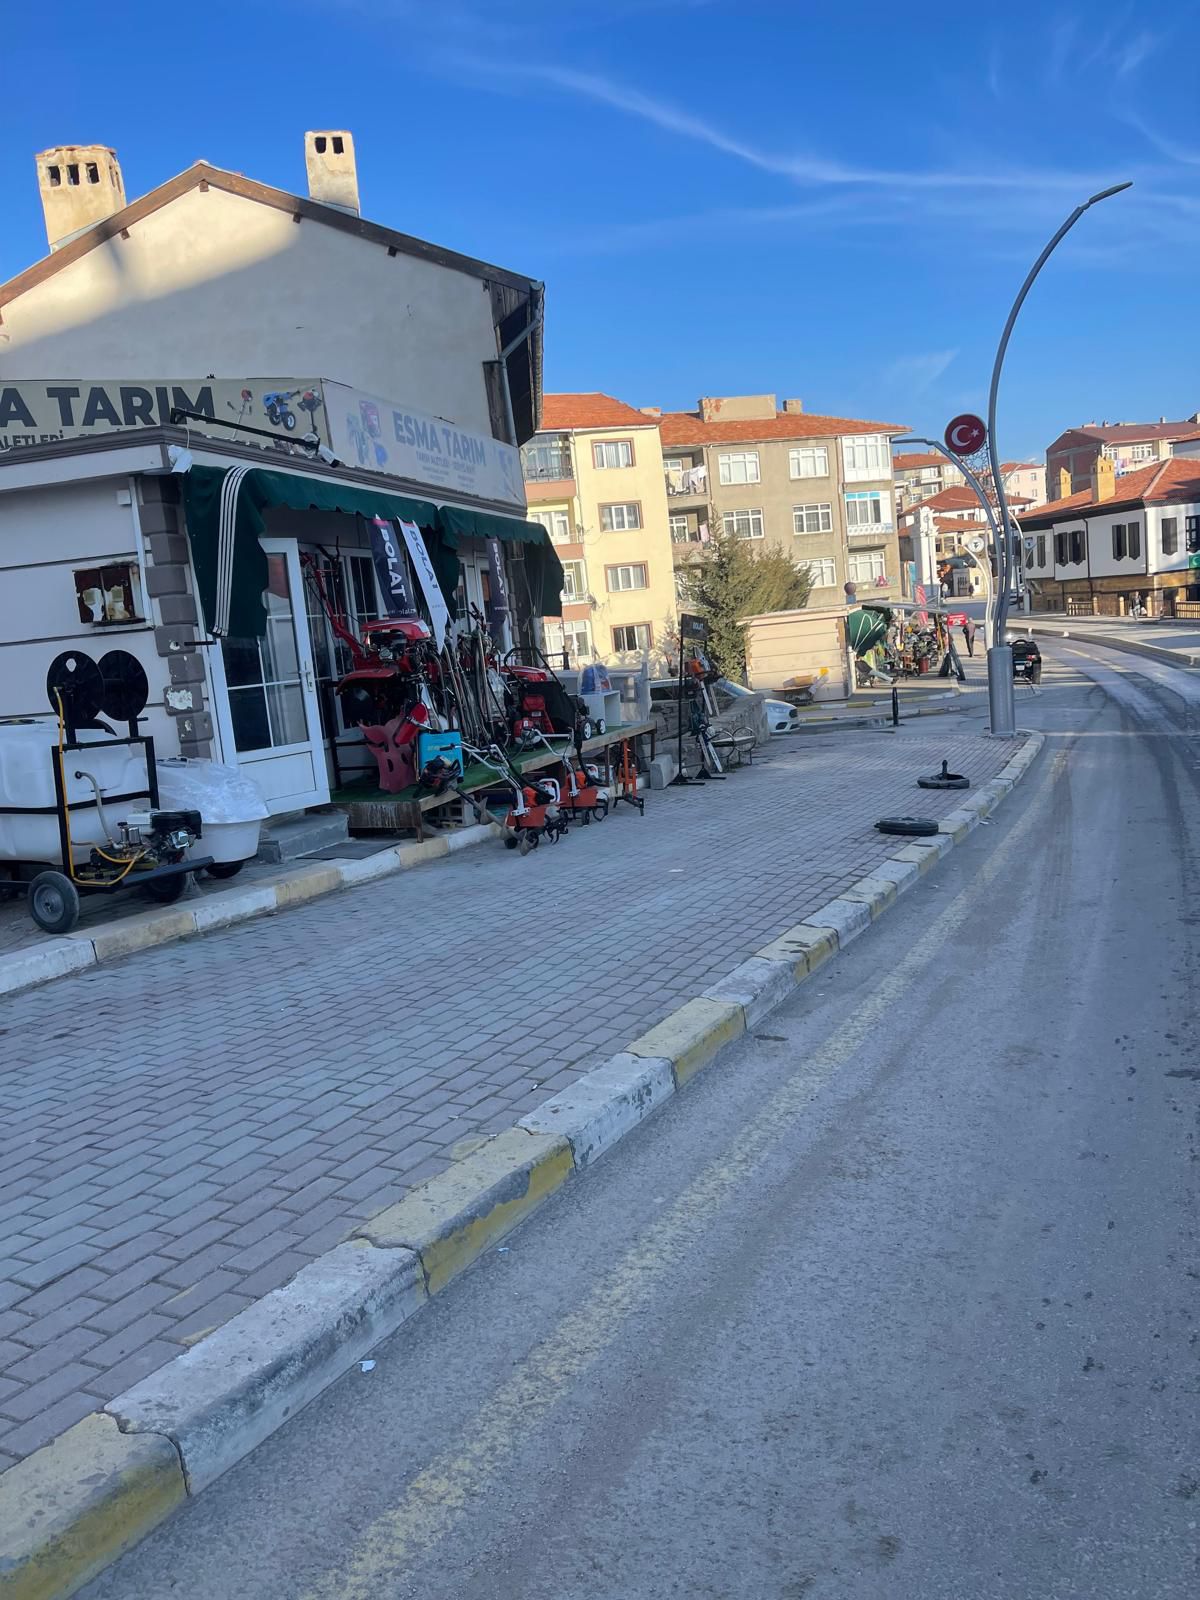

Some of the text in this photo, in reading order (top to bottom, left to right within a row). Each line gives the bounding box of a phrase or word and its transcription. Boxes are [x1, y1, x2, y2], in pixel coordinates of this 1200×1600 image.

[0, 386, 217, 427] A TARIM
[392, 410, 487, 467] ESMA TARIM
